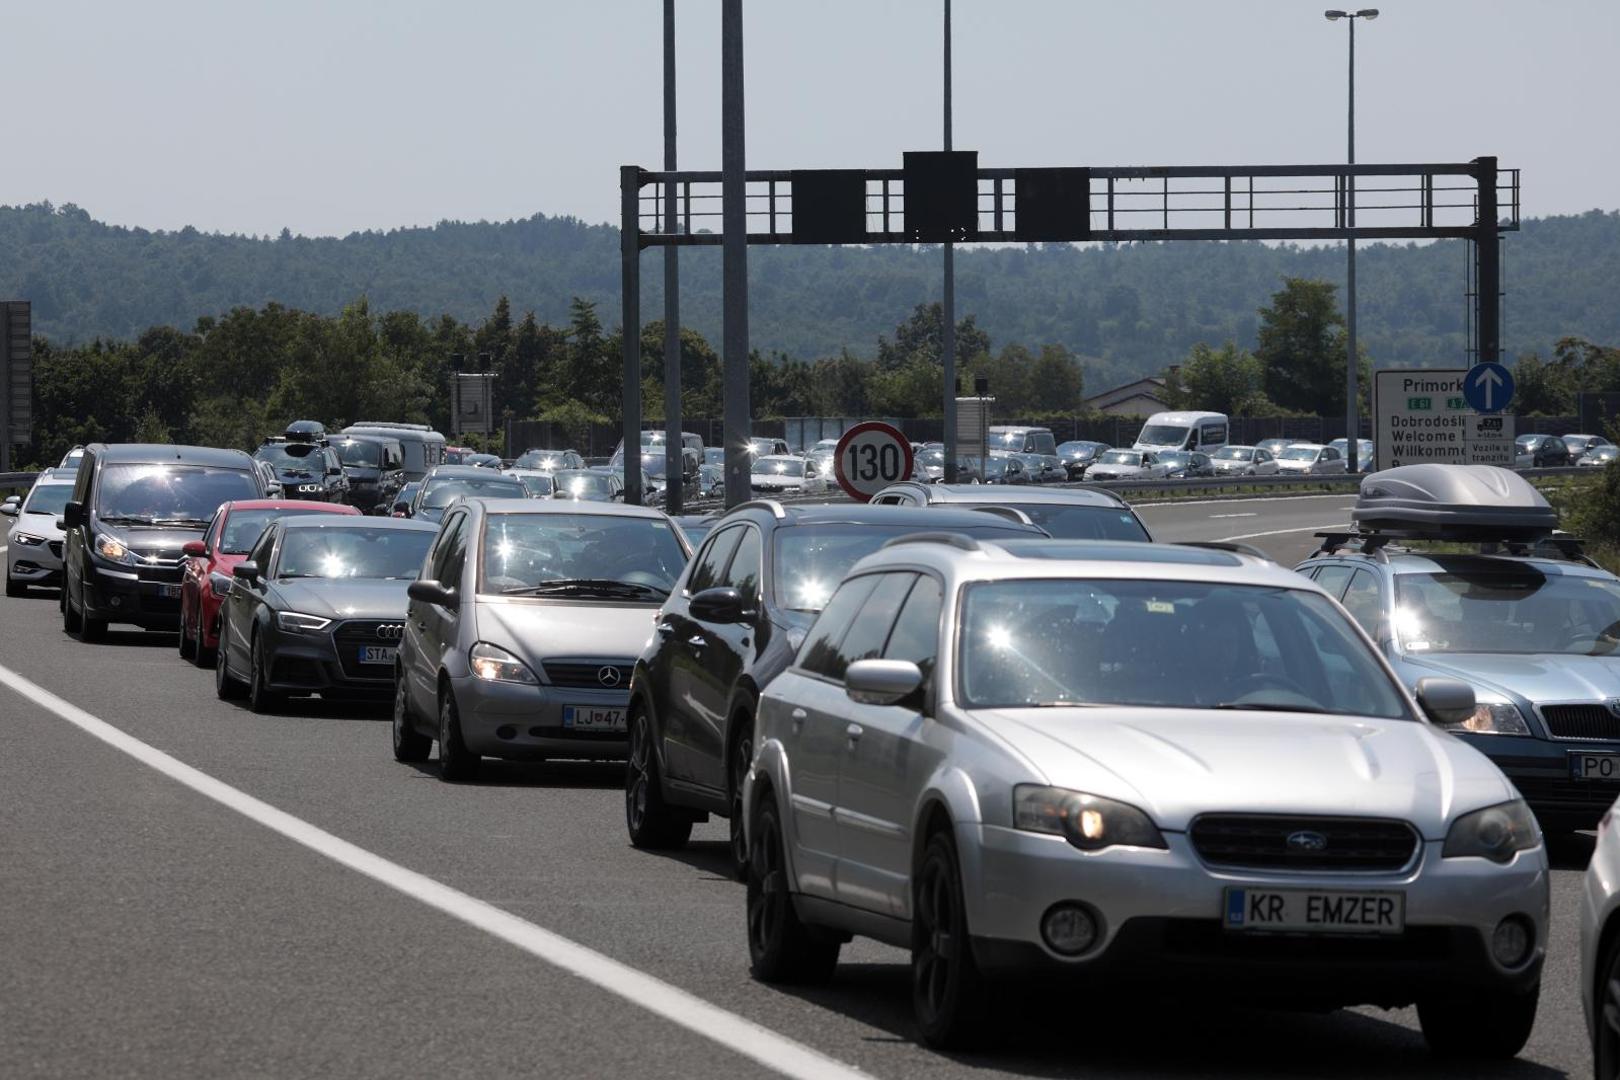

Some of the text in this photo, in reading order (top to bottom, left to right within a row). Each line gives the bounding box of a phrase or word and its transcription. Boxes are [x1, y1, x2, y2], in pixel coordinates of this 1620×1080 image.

[1391, 430, 1456, 442] Welcome
[849, 443, 900, 481] 130
[1472, 454, 1510, 462] tranzitu
[367, 647, 388, 660] STA
[576, 709, 593, 725] LJ
[1250, 893, 1395, 925] KR EMZER
